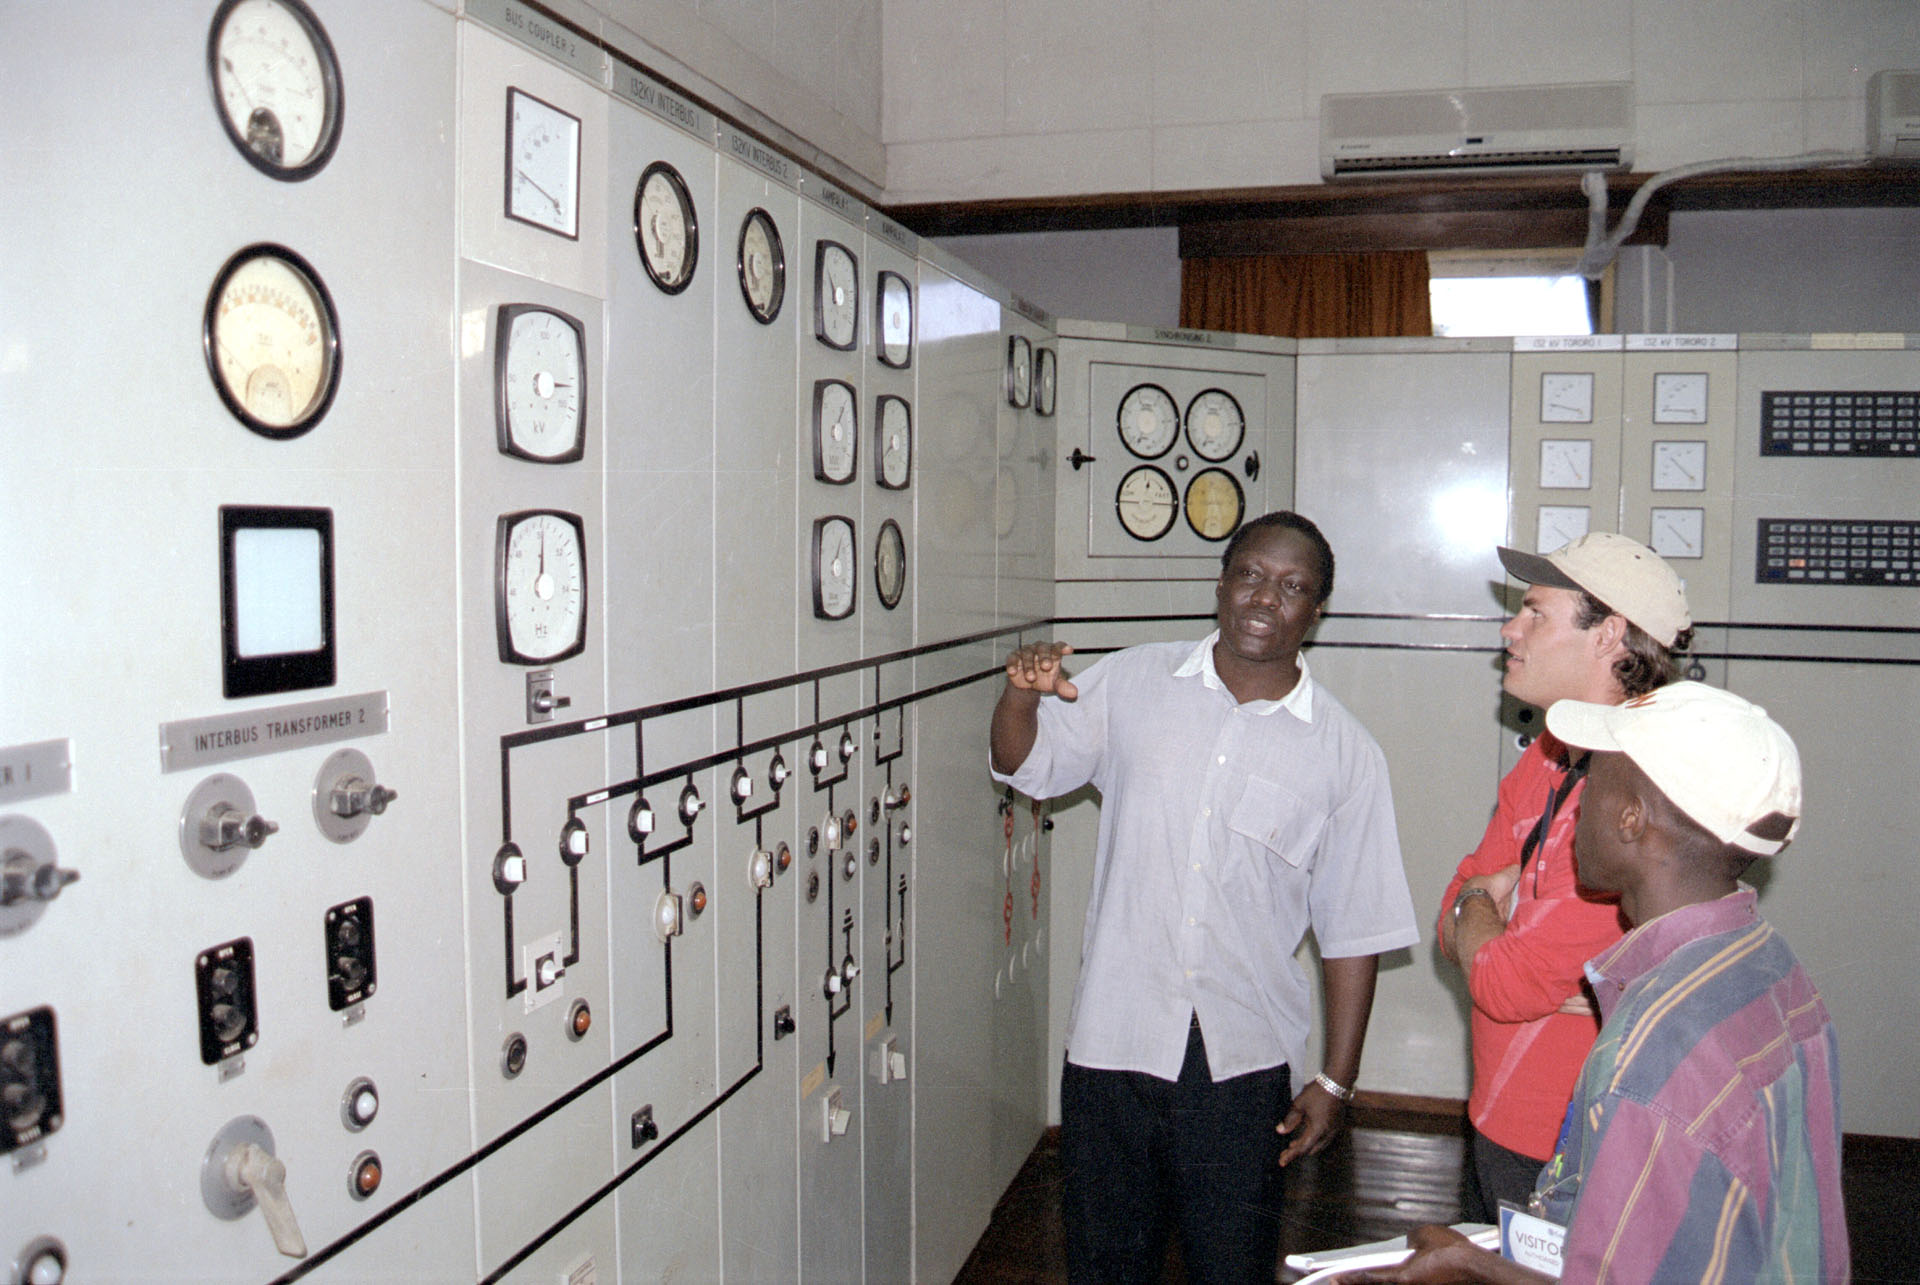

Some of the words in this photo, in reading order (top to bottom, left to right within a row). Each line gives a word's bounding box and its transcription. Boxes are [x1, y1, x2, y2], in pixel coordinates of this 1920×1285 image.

[506, 7, 523, 29] BUS
[528, 20, 568, 53] COUPLER
[570, 43, 576, 58] 2
[658, 92, 695, 128] INTERBUS
[533, 420, 545, 434] kV
[195, 725, 259, 752] INTERBUS
[266, 710, 352, 740] TRANSFORMER
[358, 708, 366, 724] 2
